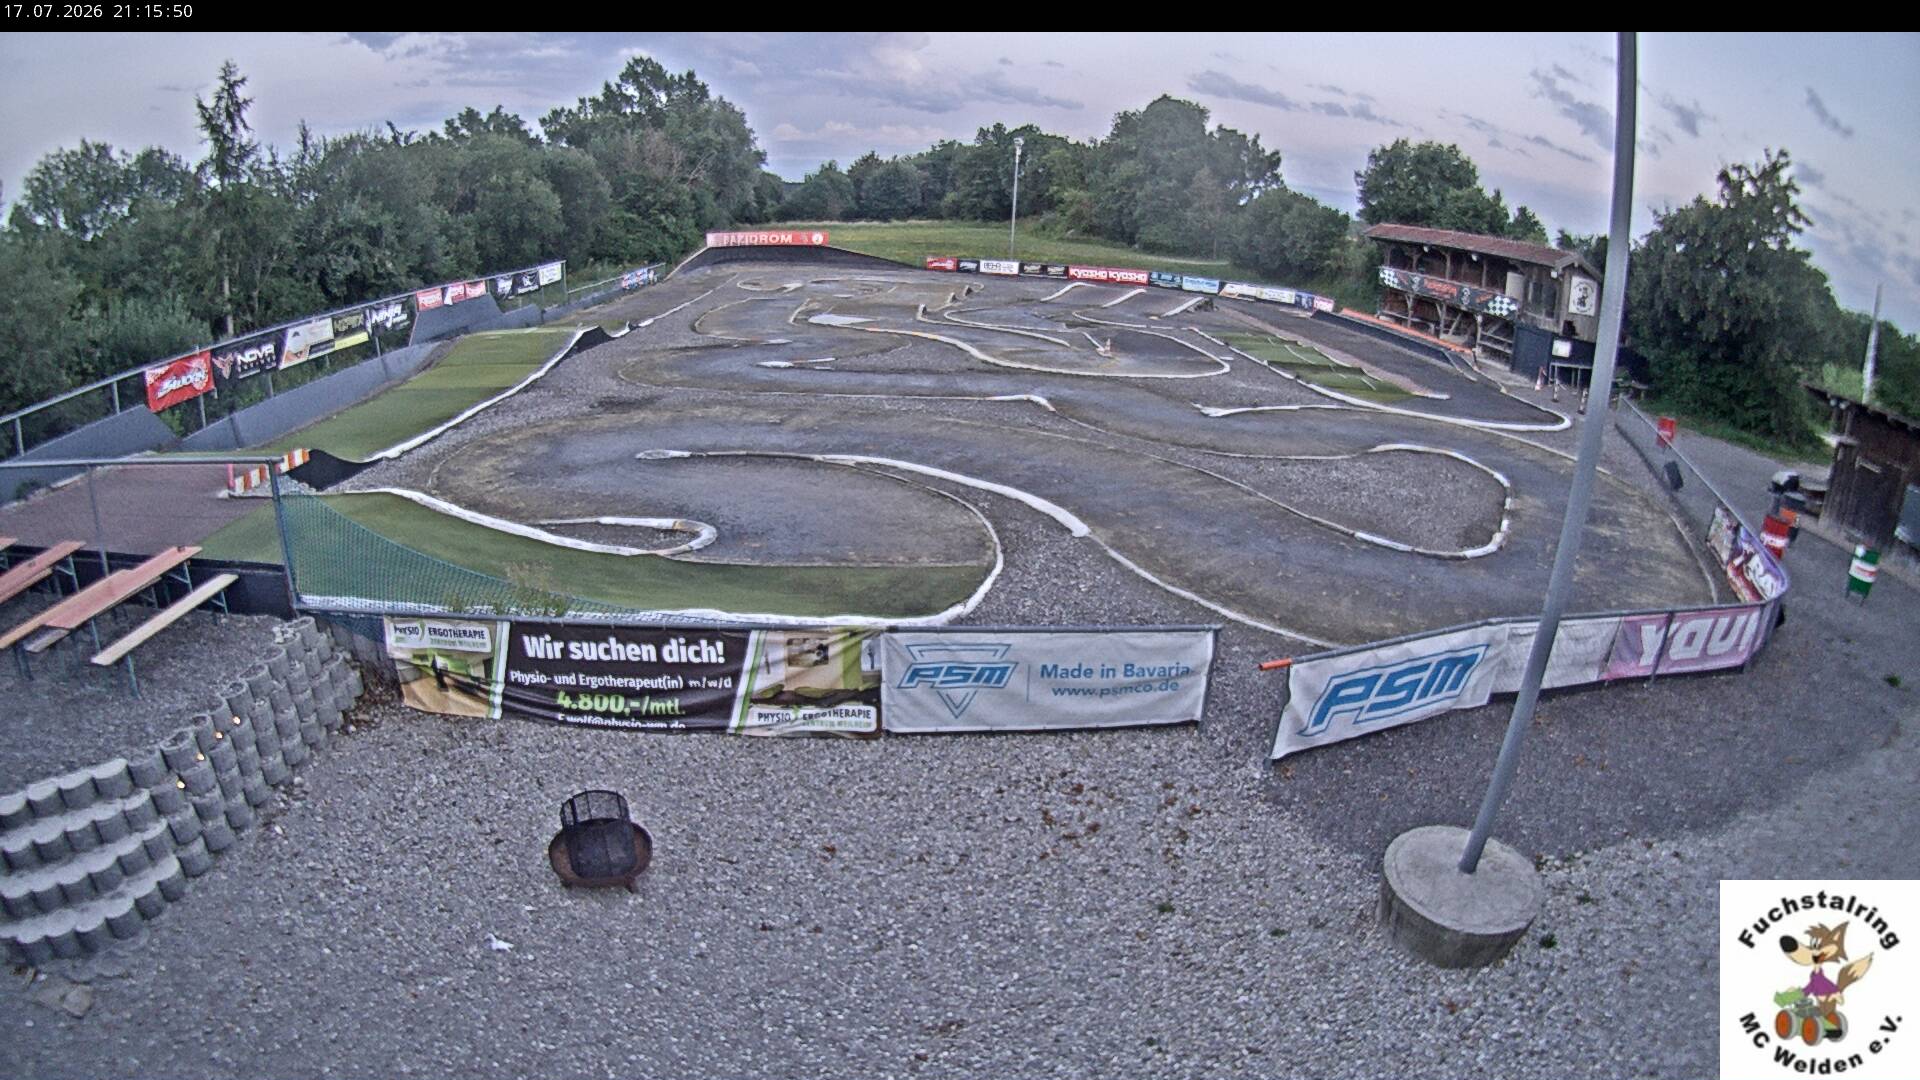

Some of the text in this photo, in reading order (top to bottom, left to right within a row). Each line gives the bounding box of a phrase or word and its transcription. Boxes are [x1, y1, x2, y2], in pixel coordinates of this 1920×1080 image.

[428, 627, 486, 640] ERGOTHERAPIE
[522, 634, 725, 664] Wir suchen dich!
[510, 670, 552, 686] Physio-
[554, 674, 576, 686] und
[579, 674, 683, 690] Ergotherapeut(in)
[904, 664, 1010, 687] PSM
[1040, 661, 1191, 680] Made in Bavaria
[1052, 679, 1180, 699] www.psmco.de
[1311, 651, 1485, 730] PSM
[802, 708, 872, 721] ERGOTHERAPIE
